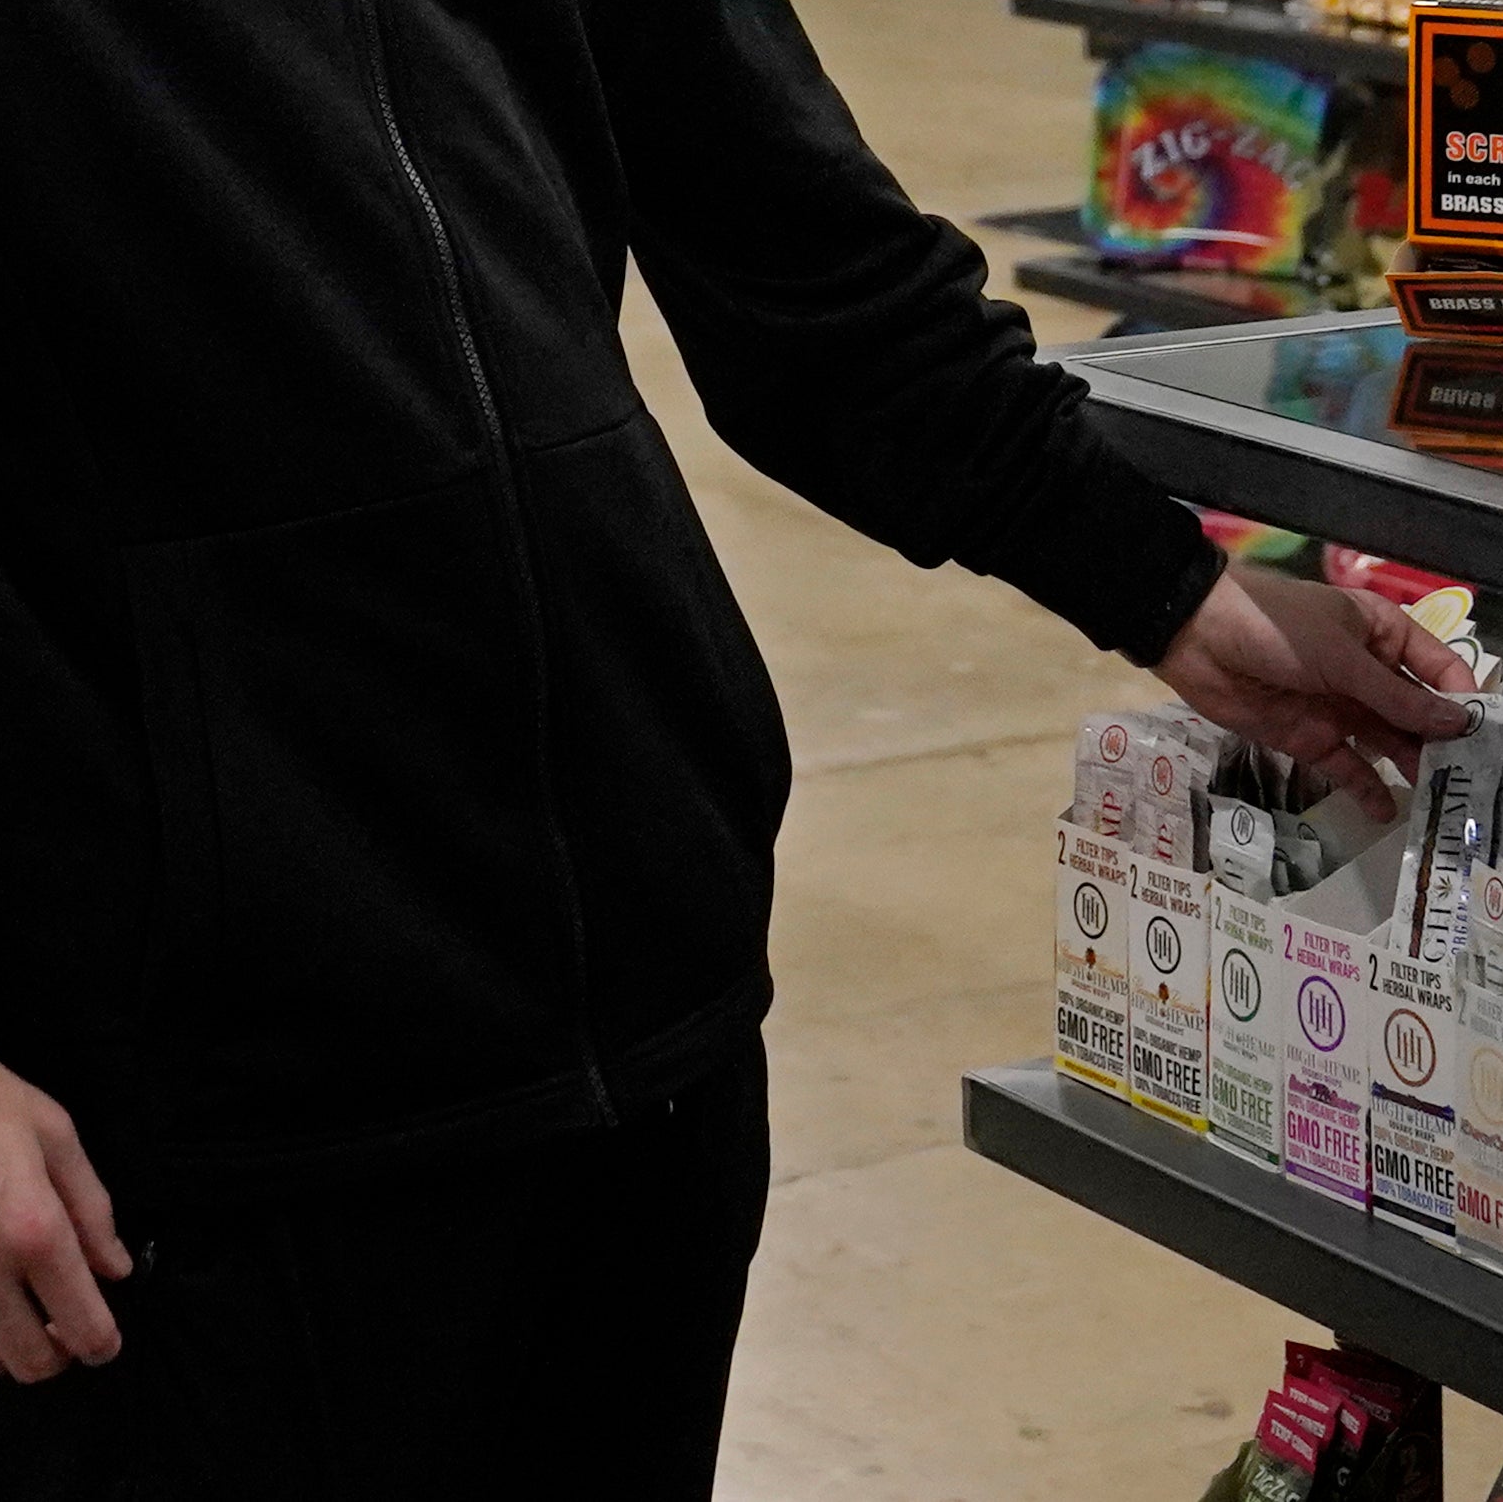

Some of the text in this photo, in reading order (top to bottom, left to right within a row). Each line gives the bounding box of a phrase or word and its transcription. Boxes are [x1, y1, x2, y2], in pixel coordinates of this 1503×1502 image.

[1447, 170, 1462, 184] in
[1465, 173, 1501, 187] each
[1428, 296, 1496, 312] BRASS
[1058, 829, 1066, 865] 2
[1130, 863, 1138, 899] 2
[1147, 870, 1193, 899] FILTER TIPS
[1169, 896, 1202, 920] WRAPS
[1283, 923, 1293, 960] 2
[1303, 931, 1351, 961] FILTER TIPS
[1328, 959, 1361, 983] WRAPS
[1368, 953, 1379, 991] 2
[1390, 960, 1442, 991] FILTER TIPS
[1416, 988, 1453, 1013] WRAPS
[1057, 1006, 1125, 1060] GMO FREE
[1132, 1043, 1163, 1082] GMO
[1165, 1058, 1201, 1097] FREE
[1211, 1072, 1273, 1129] GMO FREE
[1287, 1110, 1361, 1166] GMO FREE
[1373, 1143, 1410, 1186] GMO
[1414, 1158, 1455, 1200] FREE
[1456, 1181, 1491, 1225] GMO
